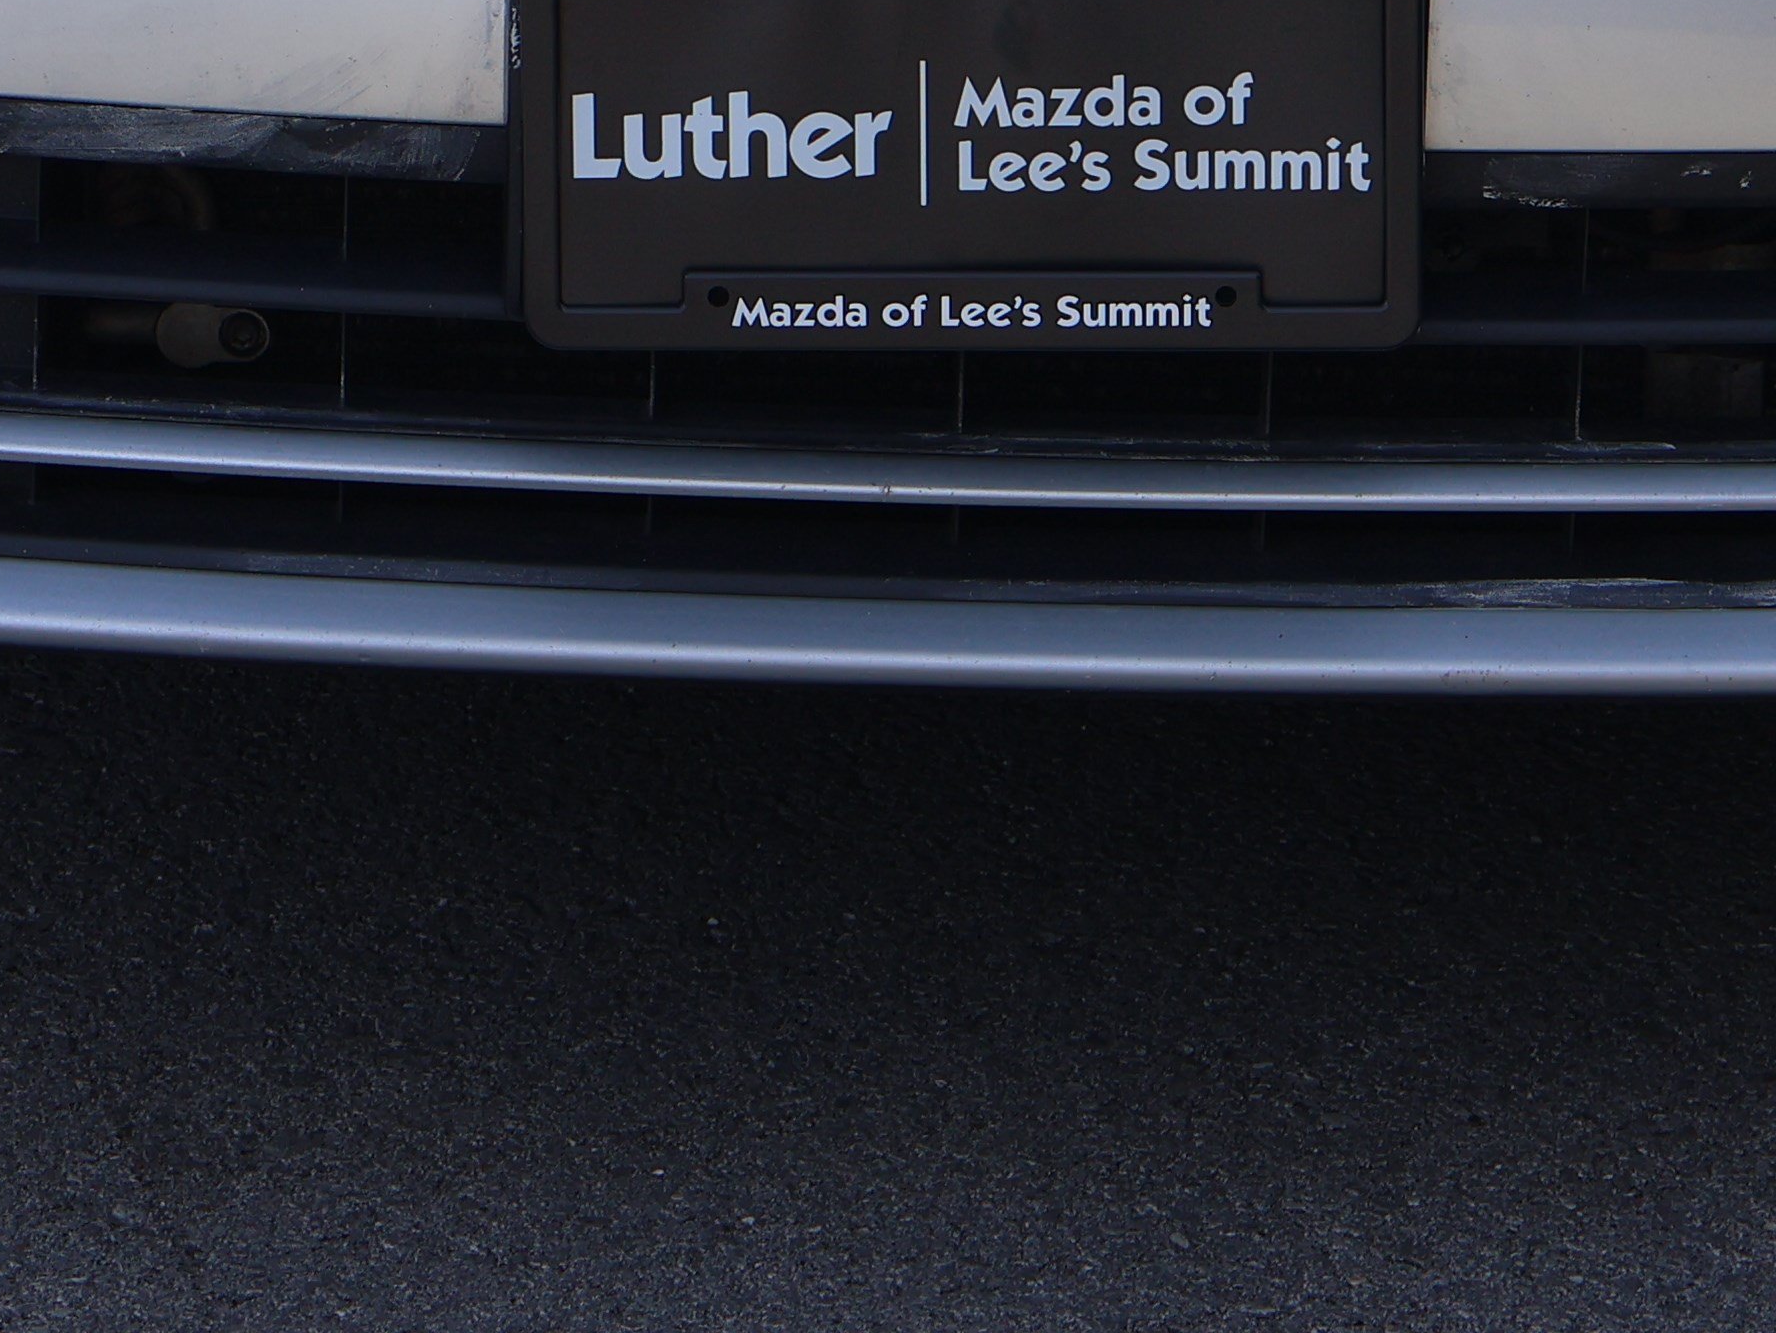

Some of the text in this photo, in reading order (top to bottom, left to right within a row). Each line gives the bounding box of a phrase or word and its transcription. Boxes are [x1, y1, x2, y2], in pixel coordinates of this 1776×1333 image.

[952, 70, 1255, 129] Mazda of
[571, 89, 894, 181] Luther
[957, 136, 1372, 193] Lee's Summit
[730, 293, 1213, 328] Mazda of Lee's Summit
